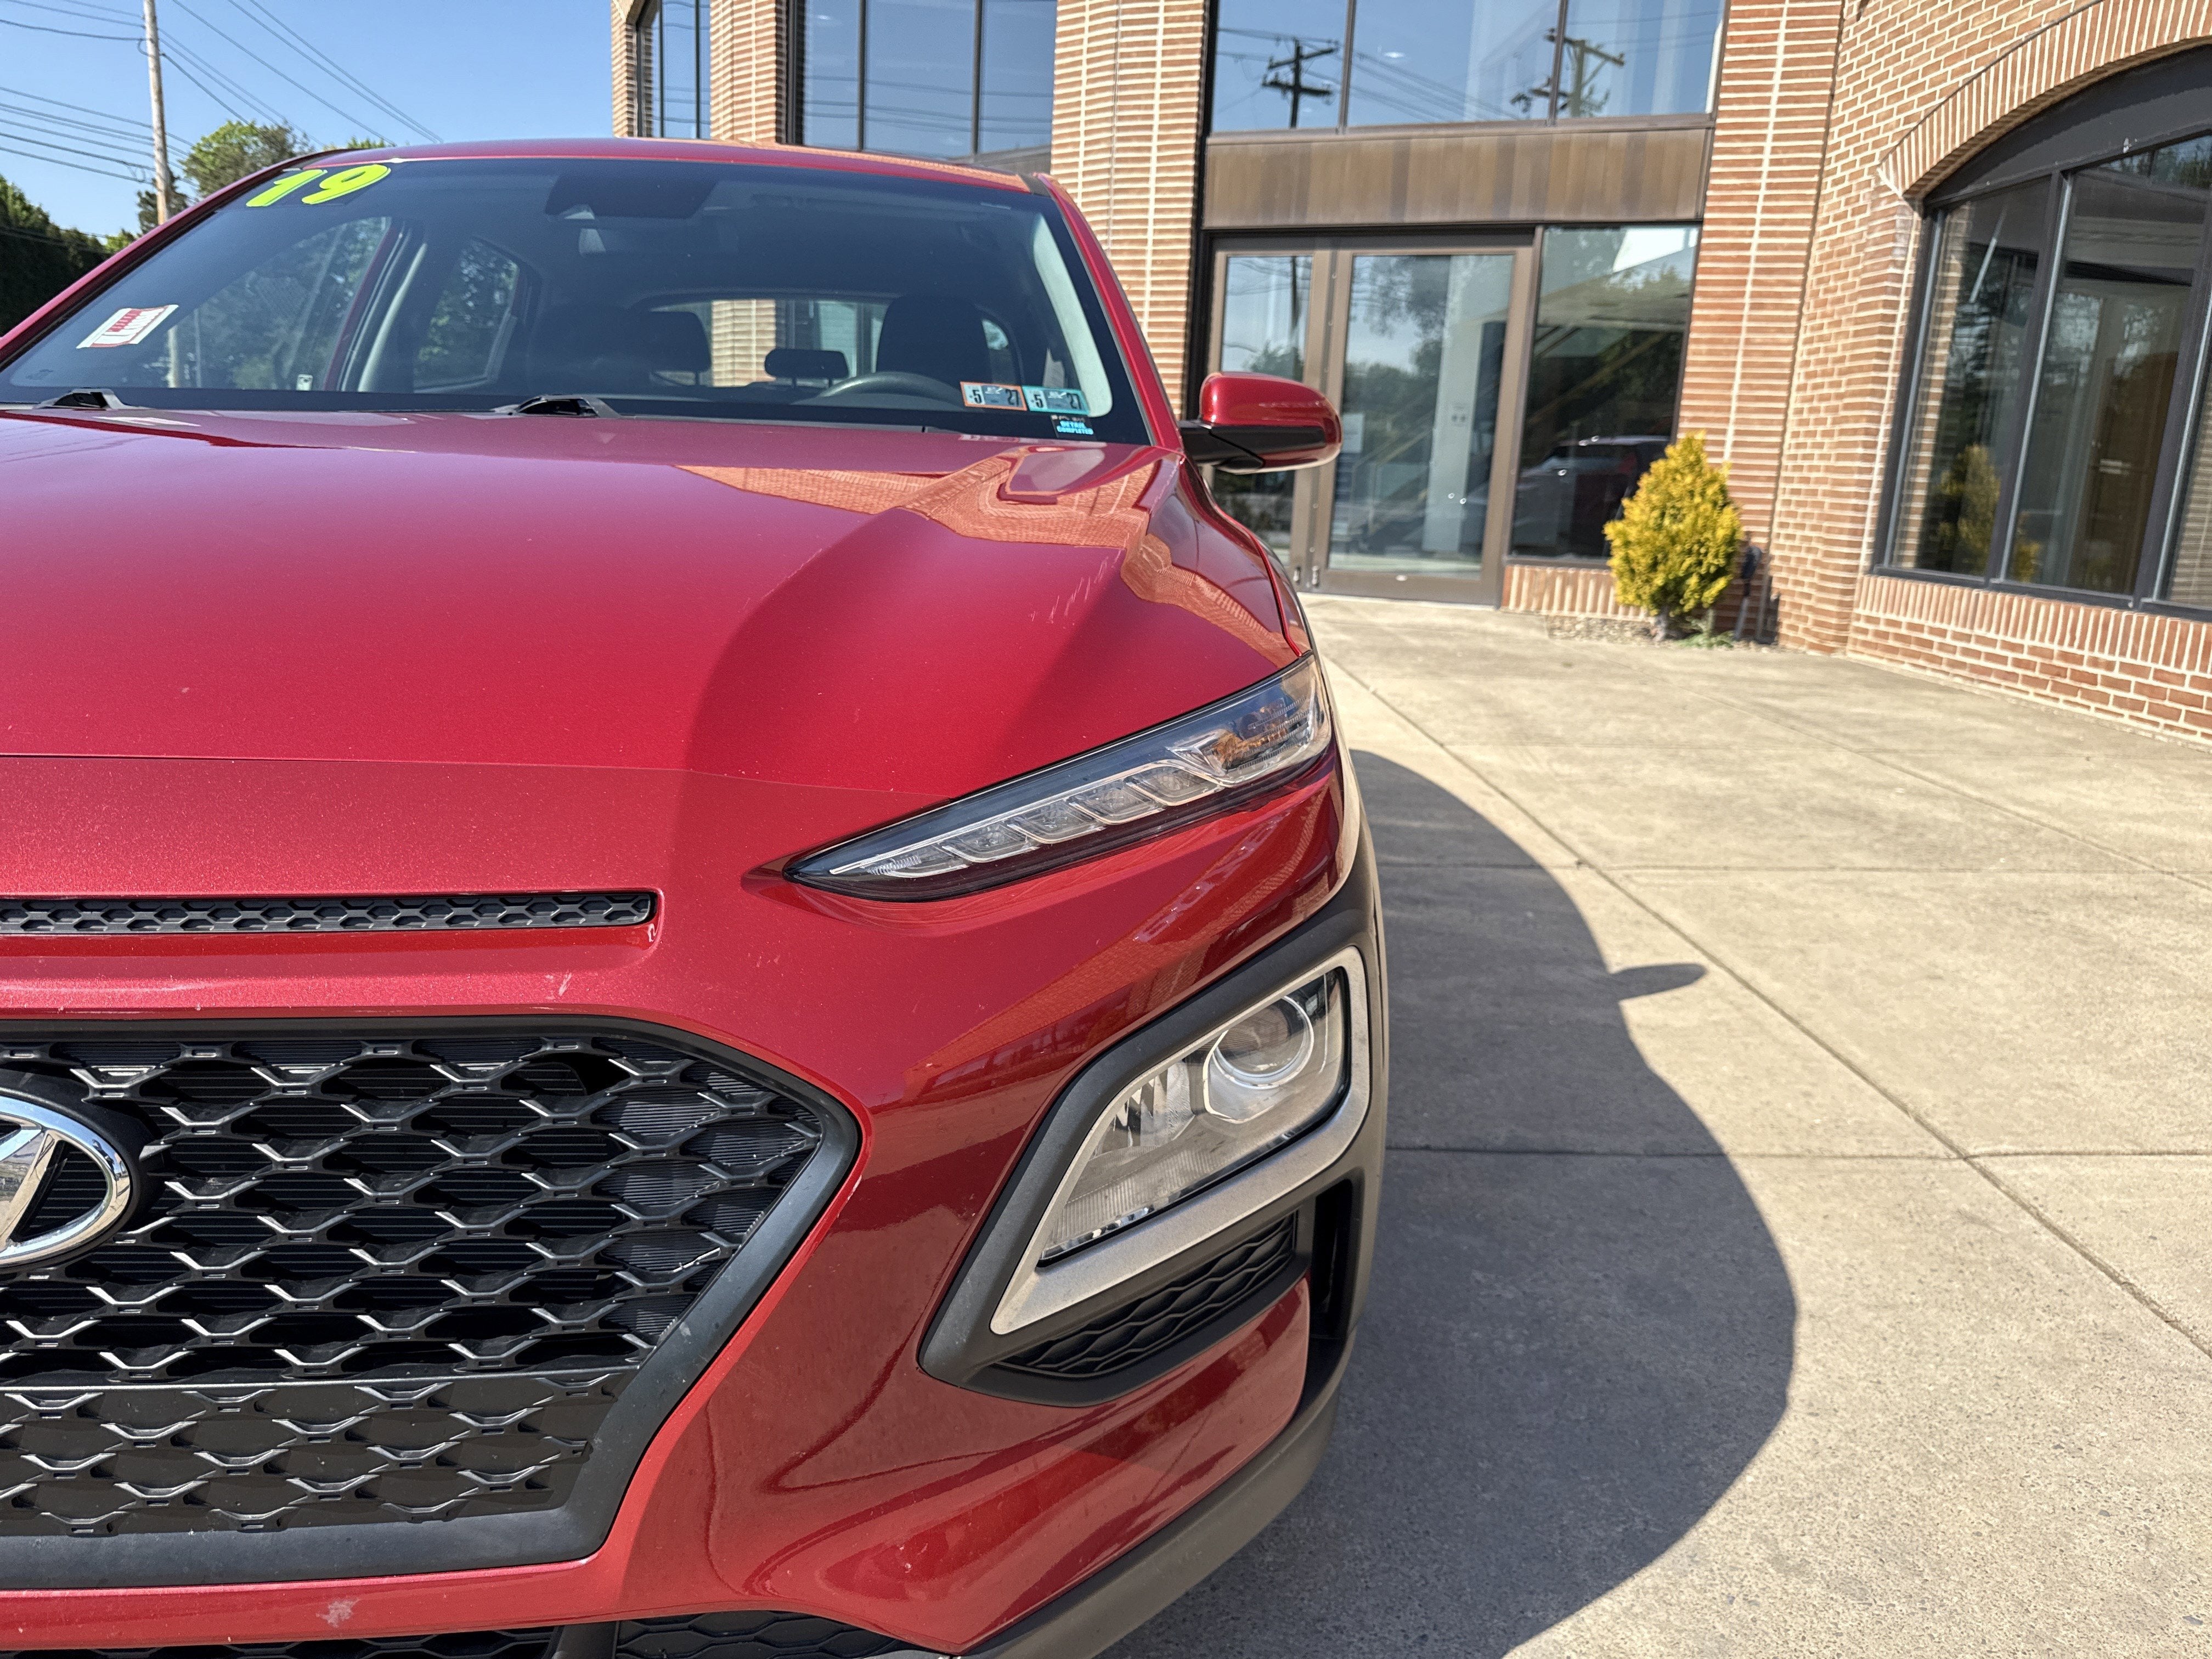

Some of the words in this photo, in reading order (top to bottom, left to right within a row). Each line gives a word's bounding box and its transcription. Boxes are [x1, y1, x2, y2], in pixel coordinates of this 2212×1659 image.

[246, 164, 391, 207] 19
[972, 389, 983, 404] 5
[1005, 388, 1019, 406] 27
[1034, 394, 1043, 408] 5
[1066, 392, 1082, 410] 27
